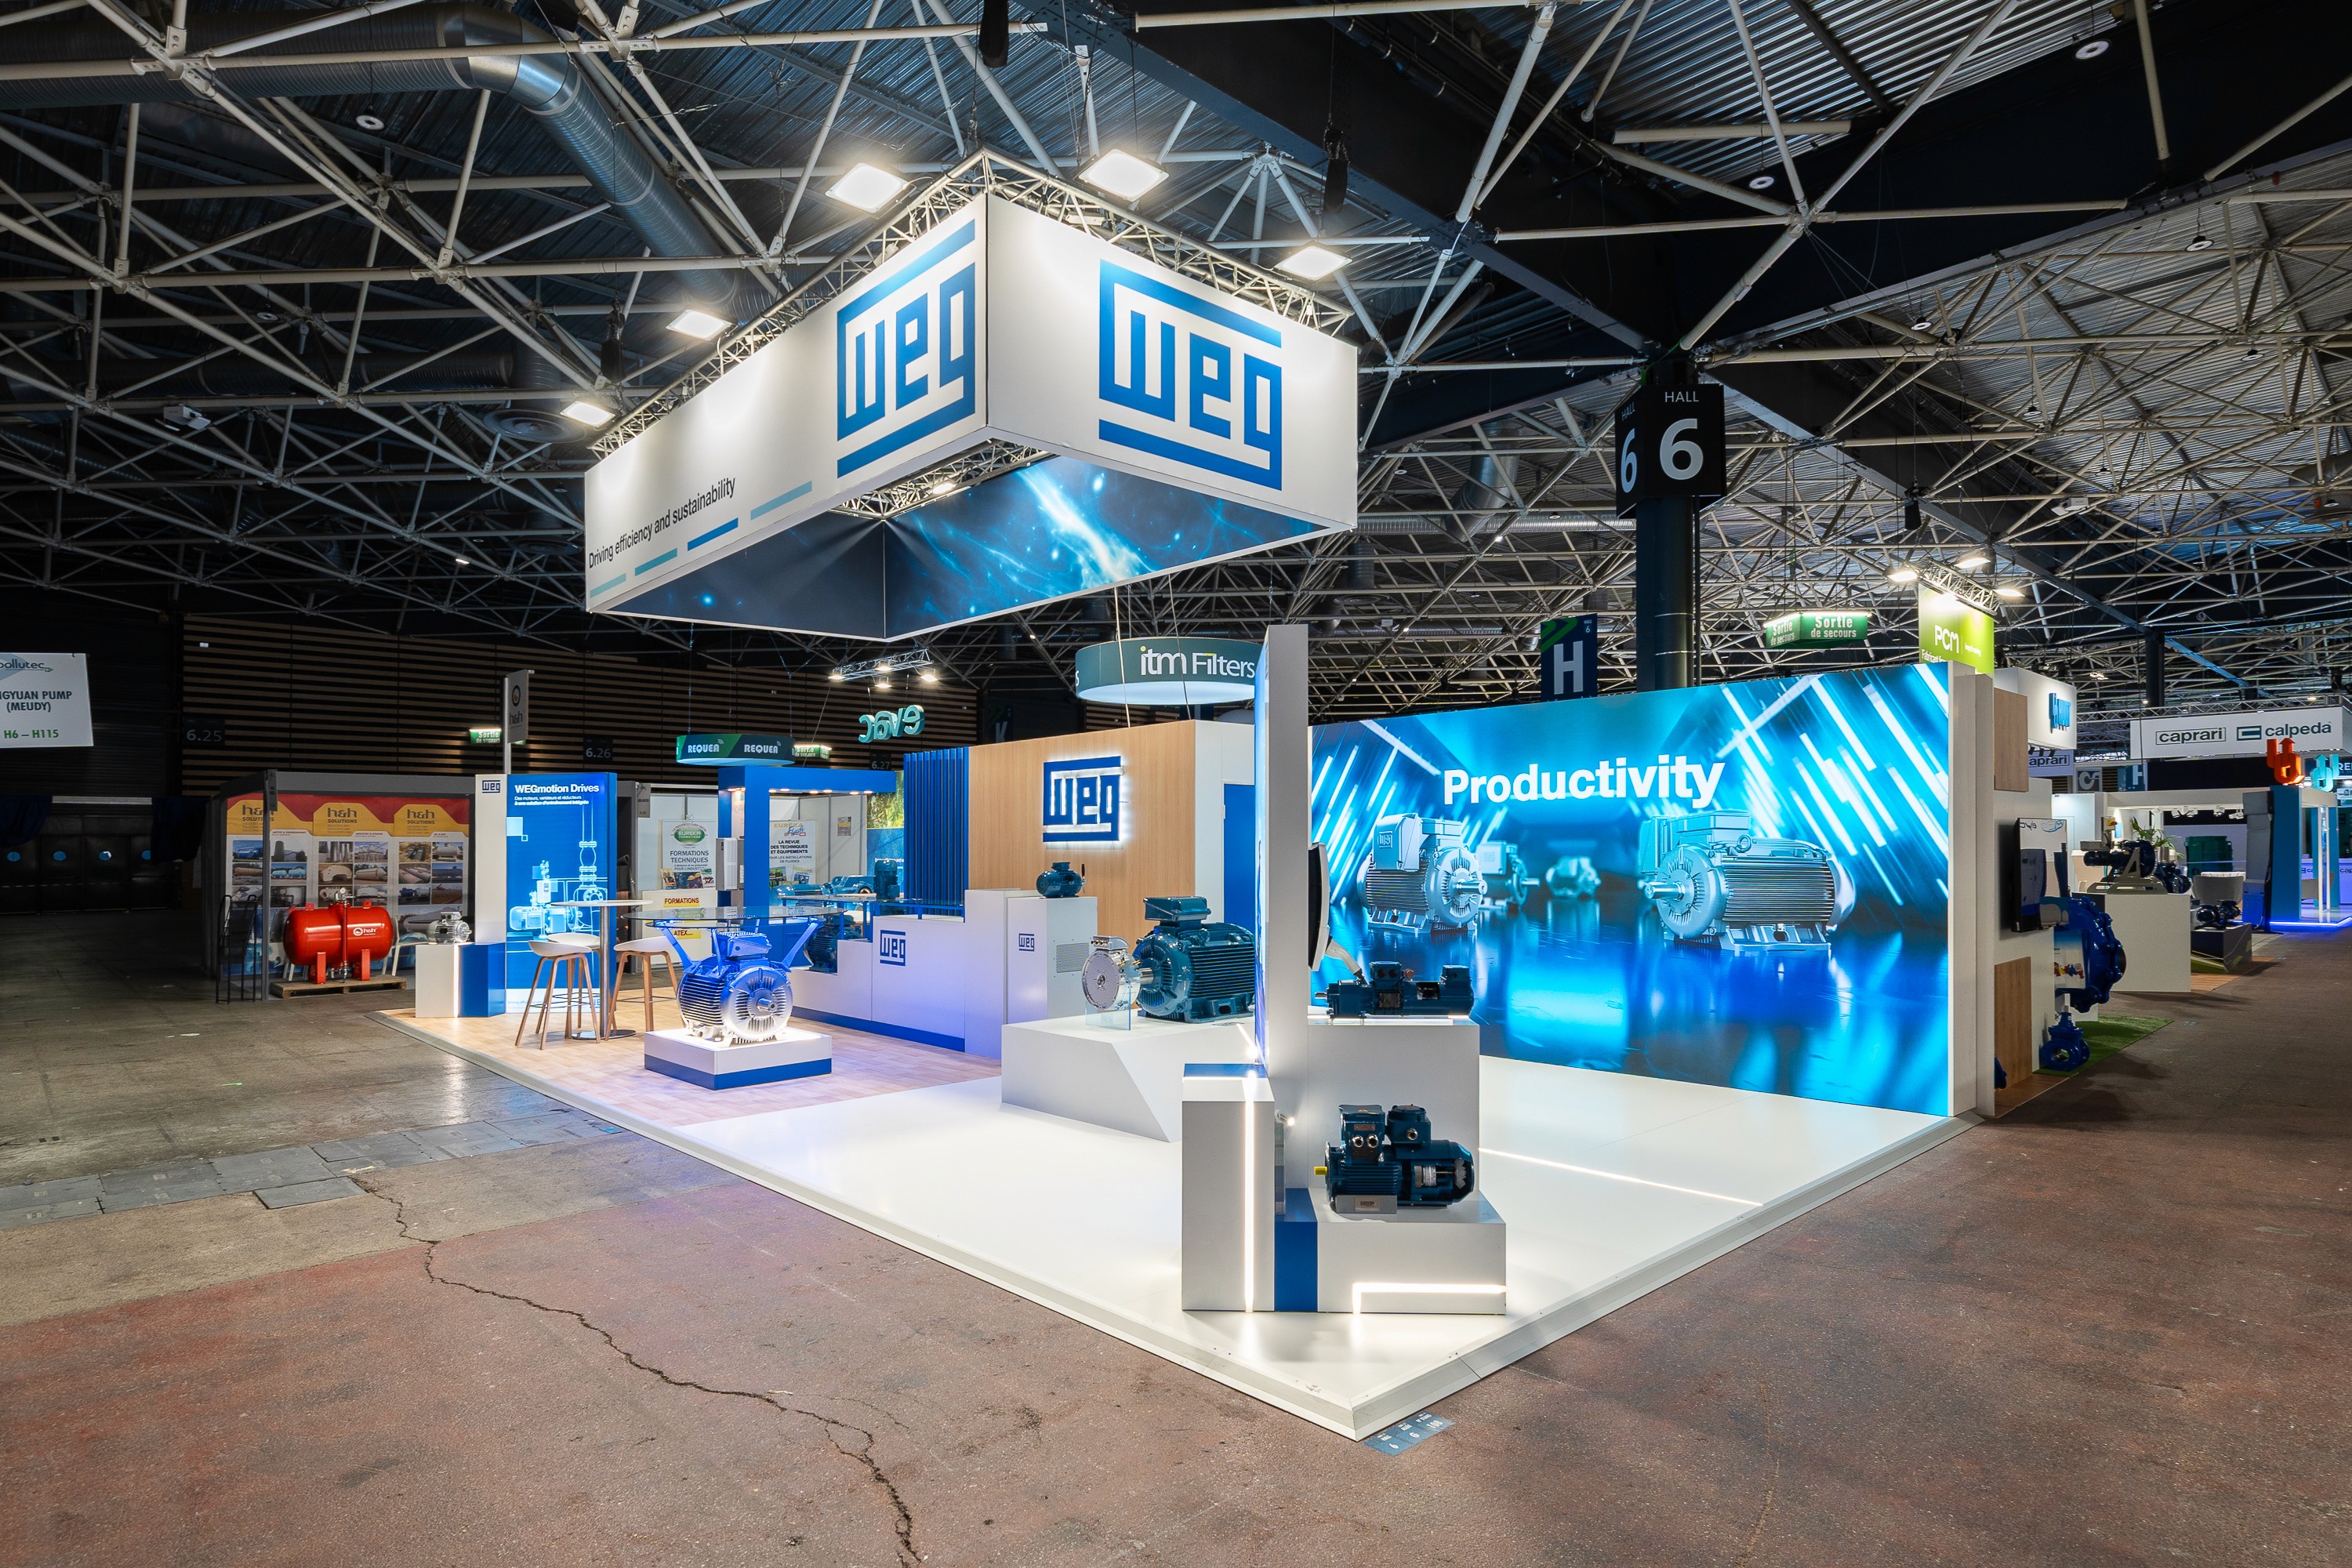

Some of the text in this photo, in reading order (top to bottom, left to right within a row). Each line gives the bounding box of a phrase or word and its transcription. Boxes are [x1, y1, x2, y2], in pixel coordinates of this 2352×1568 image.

[1665, 391, 1699, 402] HALL
[1621, 401, 1635, 422] HALL
[1660, 418, 1704, 481] 6
[1621, 428, 1637, 493] 6
[589, 477, 735, 568] Driving efficiency and sustainability
[1815, 615, 1853, 628] Sortie
[1773, 620, 1793, 637] Sortie
[1811, 628, 1857, 638] de secours
[1935, 625, 1959, 653] PCM
[1141, 645, 1255, 679] itm Filters
[1554, 641, 1583, 695] H
[0, 691, 72, 700] GYUAN PUMP
[6, 702, 51, 713] (MEUDY)
[4, 730, 19, 739] H6
[32, 729, 59, 739] H115
[187, 729, 222, 742] 6.25
[2265, 721, 2332, 738] calpeda
[2159, 728, 2223, 744] caprari
[586, 747, 611, 758] 6.26
[688, 744, 720, 753] REQUEA
[744, 744, 779, 754] REQUEA
[872, 760, 891, 769] 6.27
[2029, 755, 2067, 767] aprari
[1444, 753, 1726, 809] Productivity
[514, 783, 600, 793] WEGmotion Drives
[327, 808, 357, 818] h&h
[407, 809, 435, 819] h&h
